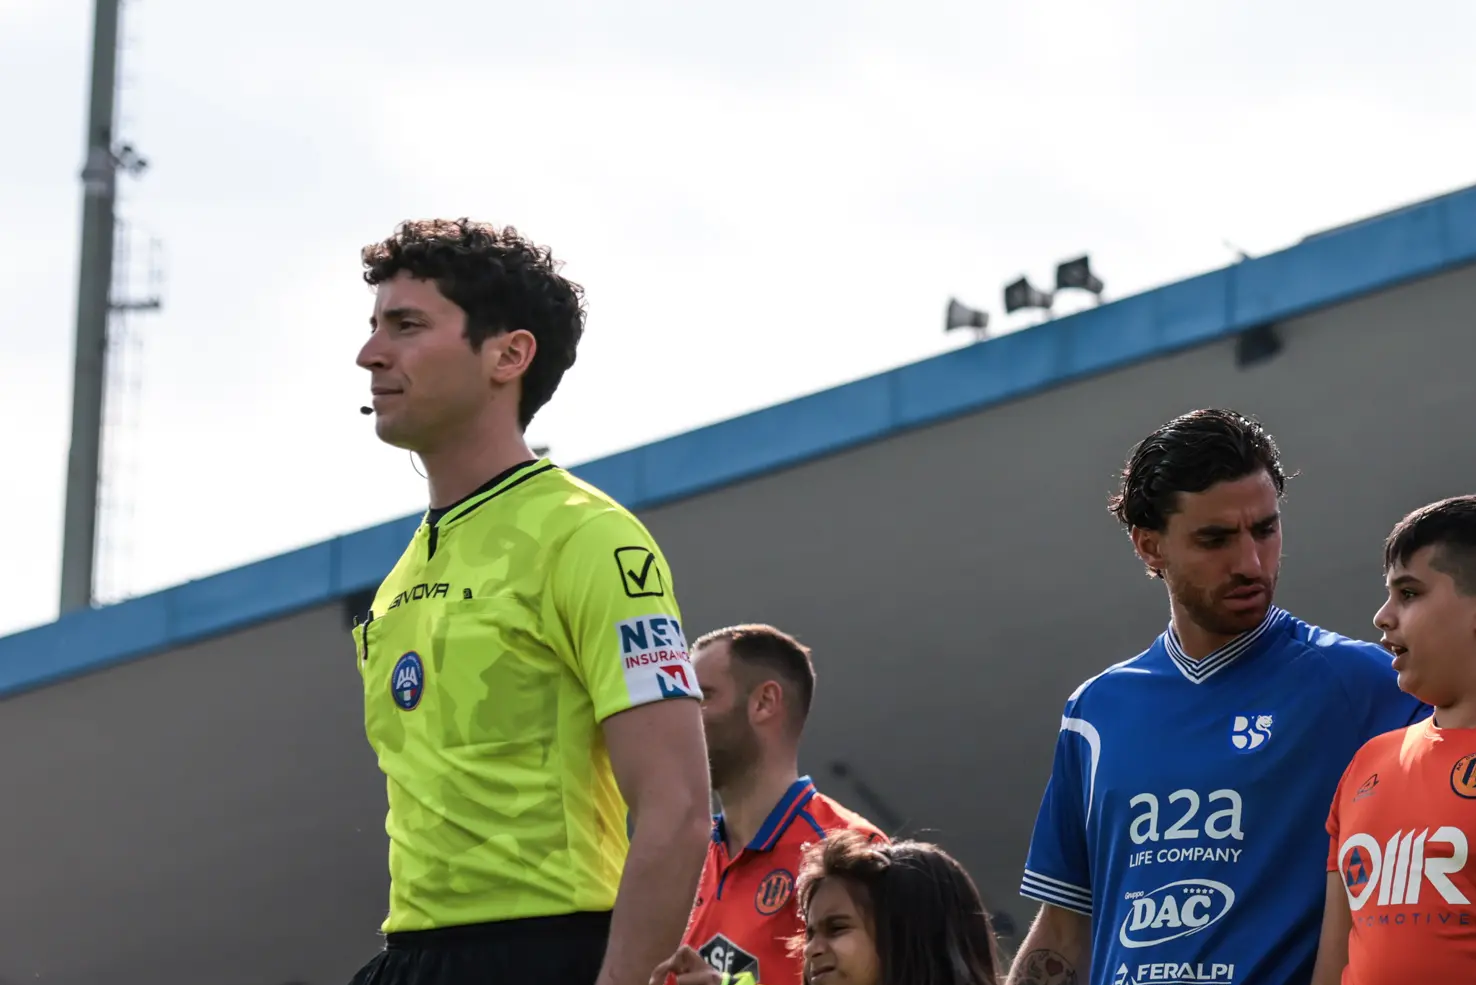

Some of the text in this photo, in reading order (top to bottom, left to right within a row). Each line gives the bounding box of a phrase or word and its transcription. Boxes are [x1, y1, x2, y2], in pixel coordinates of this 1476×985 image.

[1129, 788, 1245, 845] a2a
[1129, 847, 1243, 868] LIFE COMPANY
[1129, 894, 1212, 932] DAC
[1137, 962, 1235, 981] FERALPI
